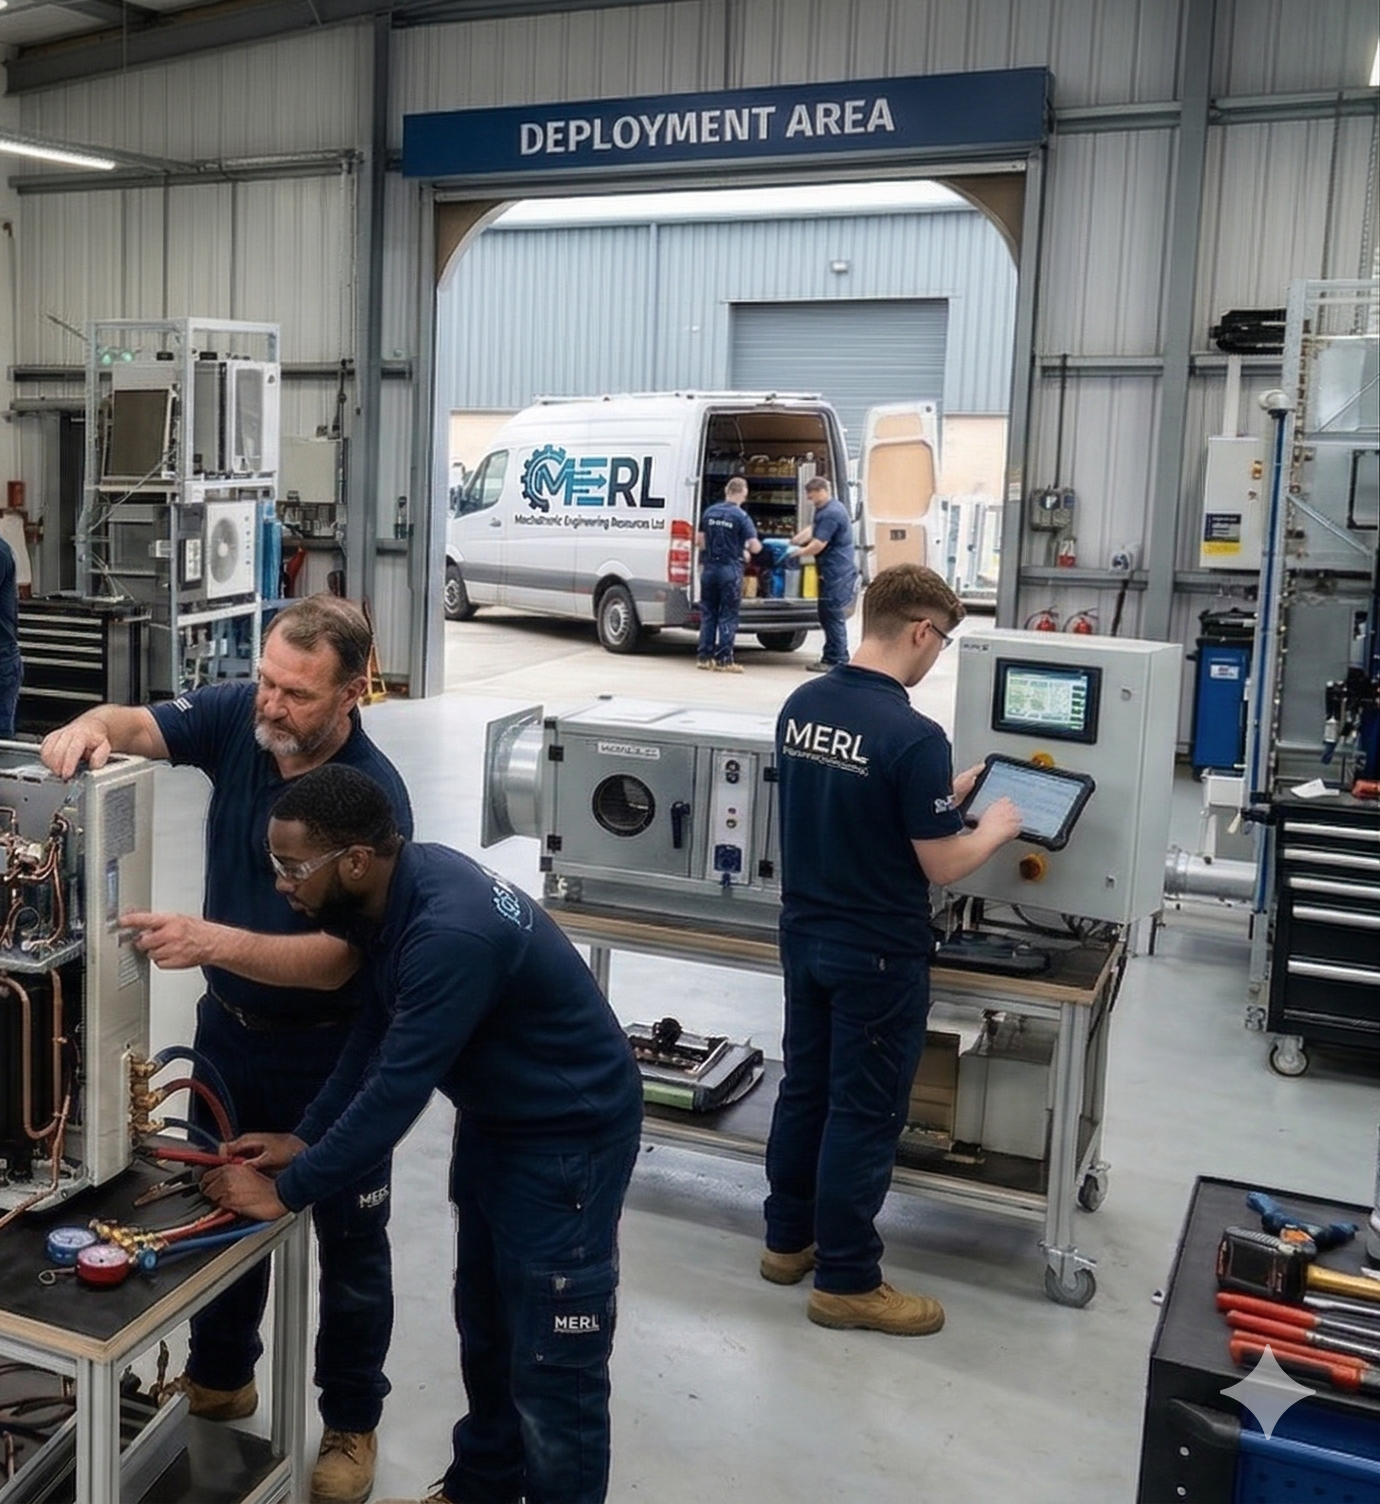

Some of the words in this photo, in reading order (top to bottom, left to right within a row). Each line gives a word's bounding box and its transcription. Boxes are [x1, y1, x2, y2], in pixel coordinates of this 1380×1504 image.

[520, 105, 776, 156] DEPLOYMENT
[785, 98, 895, 139] AREA
[532, 456, 666, 508] MERL
[784, 718, 869, 765] MERL
[554, 1313, 600, 1329] MERL
